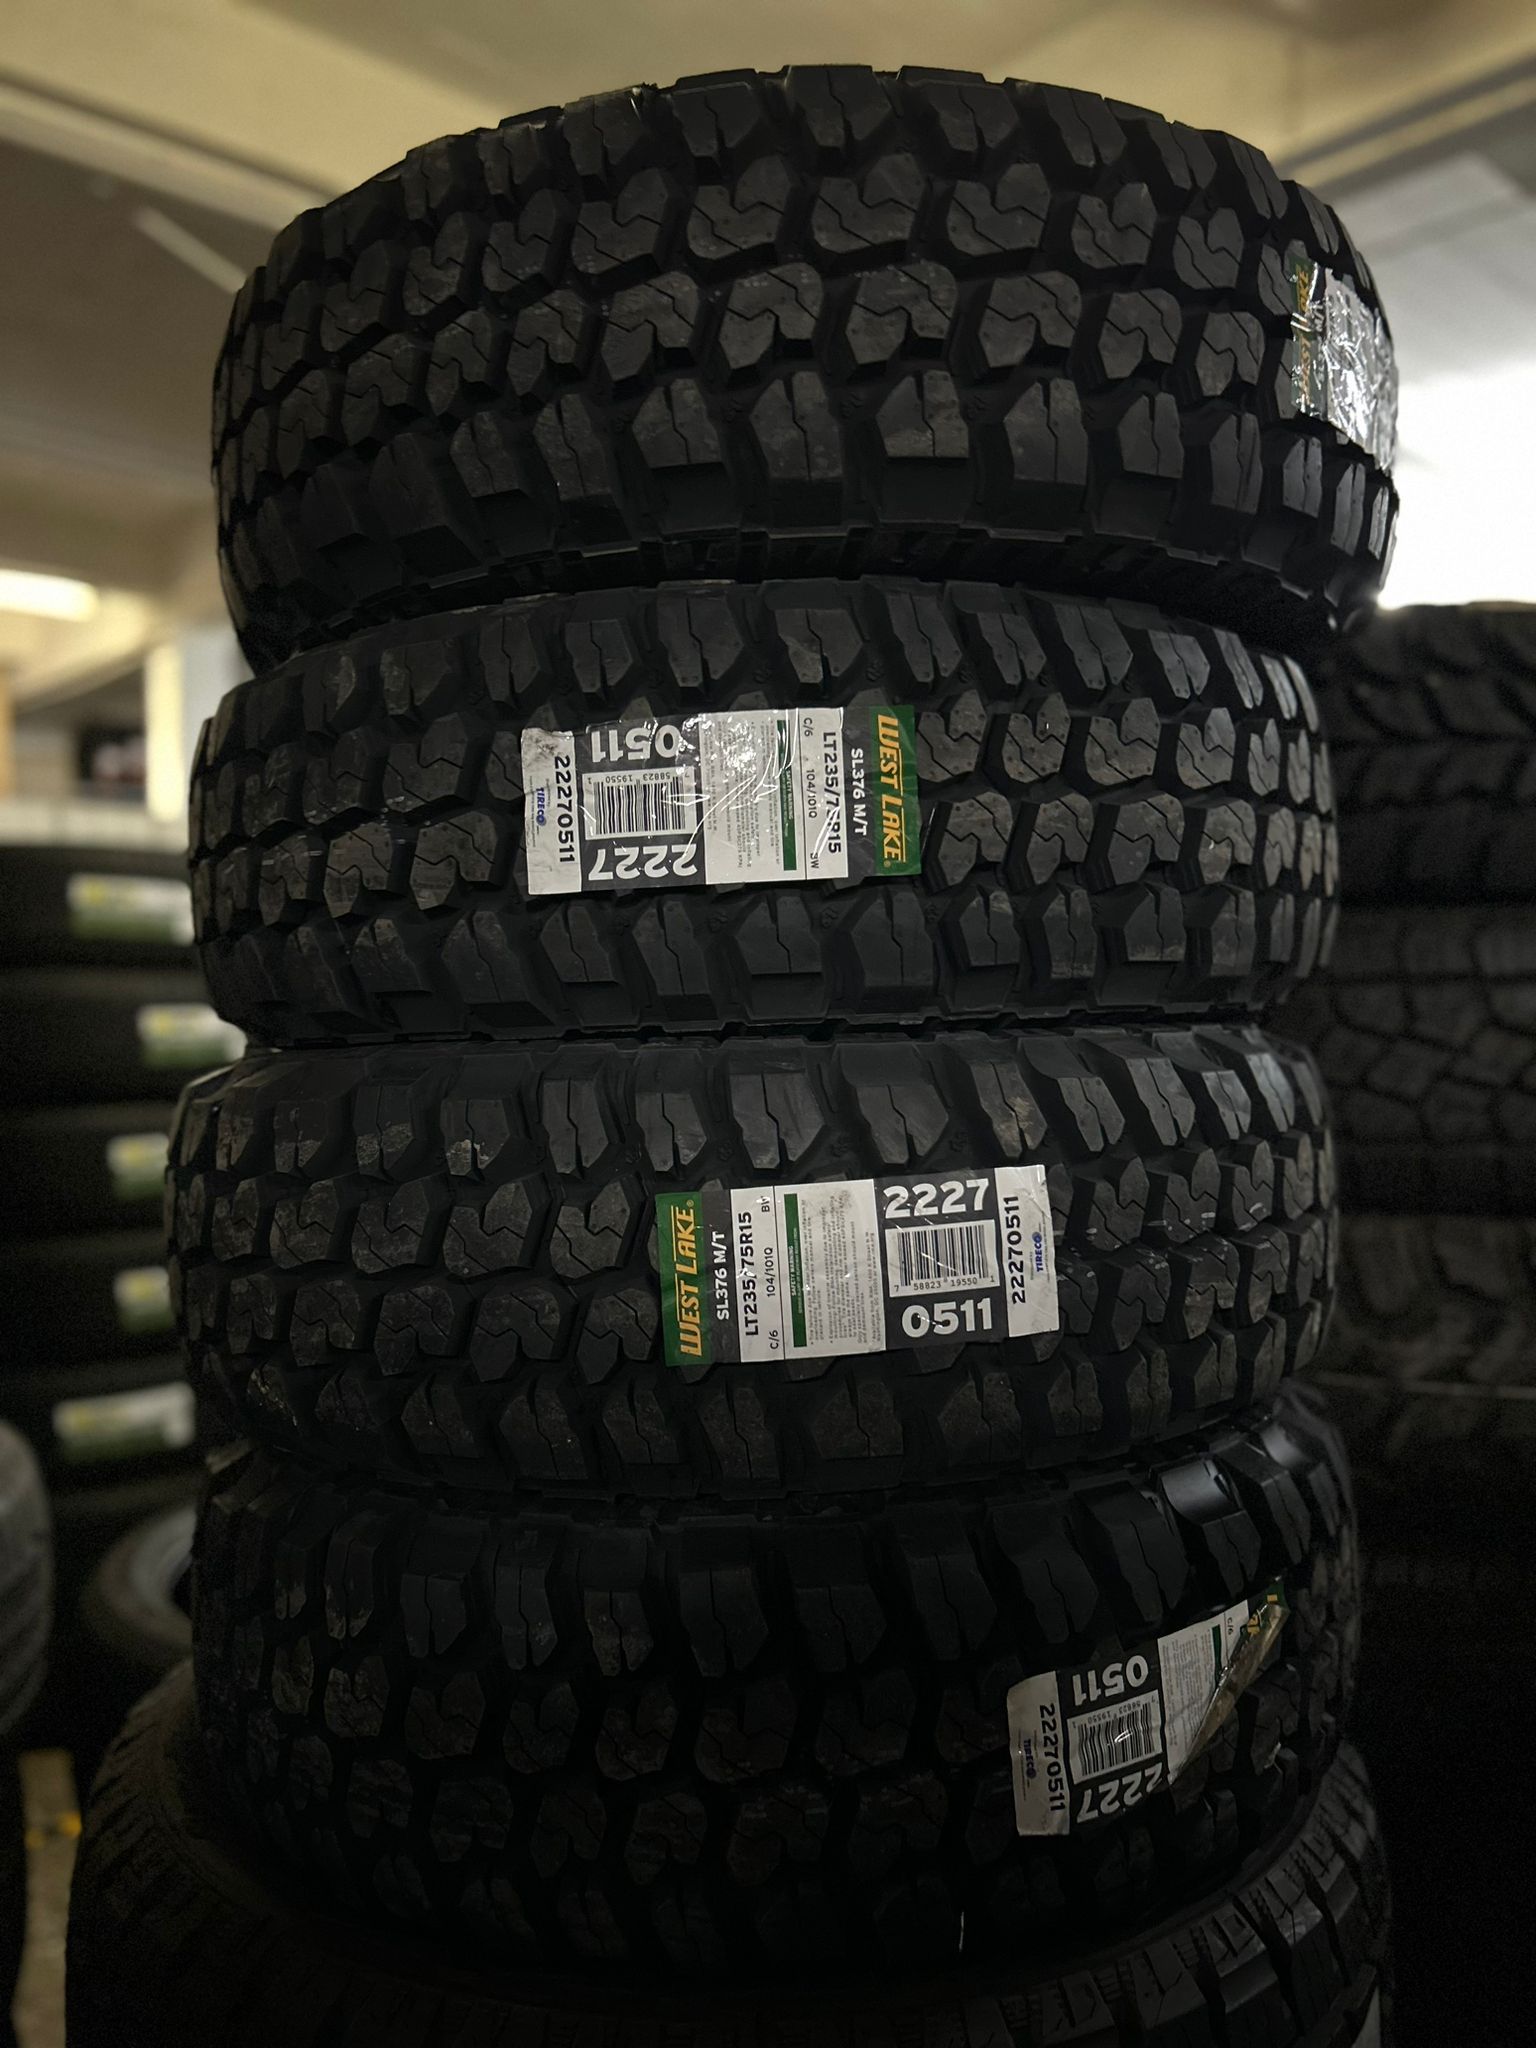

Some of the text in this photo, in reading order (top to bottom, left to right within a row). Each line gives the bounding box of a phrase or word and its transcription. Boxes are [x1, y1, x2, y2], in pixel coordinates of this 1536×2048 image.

[591, 724, 682, 763] 0511
[803, 717, 813, 737] C/6
[605, 774, 633, 784] 19550
[806, 769, 818, 819] 104/101Q
[851, 748, 868, 836] SL376 M/T
[877, 714, 904, 862] WEST LAKE
[535, 787, 547, 827] TIRECO
[554, 755, 576, 863] 22270511
[588, 843, 698, 881] 2227
[883, 1178, 990, 1219] 2227
[763, 1247, 776, 1298] 104/101Q
[1003, 1196, 1026, 1305] 22270511
[1032, 1231, 1044, 1273] TIRECO
[674, 1206, 703, 1357] WEST LAKE
[711, 1231, 730, 1321] SL376 M/T
[913, 1280, 942, 1291] 58823
[950, 1277, 978, 1288] 19550
[768, 1329, 779, 1350] C/6
[901, 1298, 993, 1338] 0511
[1072, 1655, 1149, 1707] 0511
[1039, 1703, 1066, 1812] 22270511
[1076, 1762, 1163, 1823] 2227
